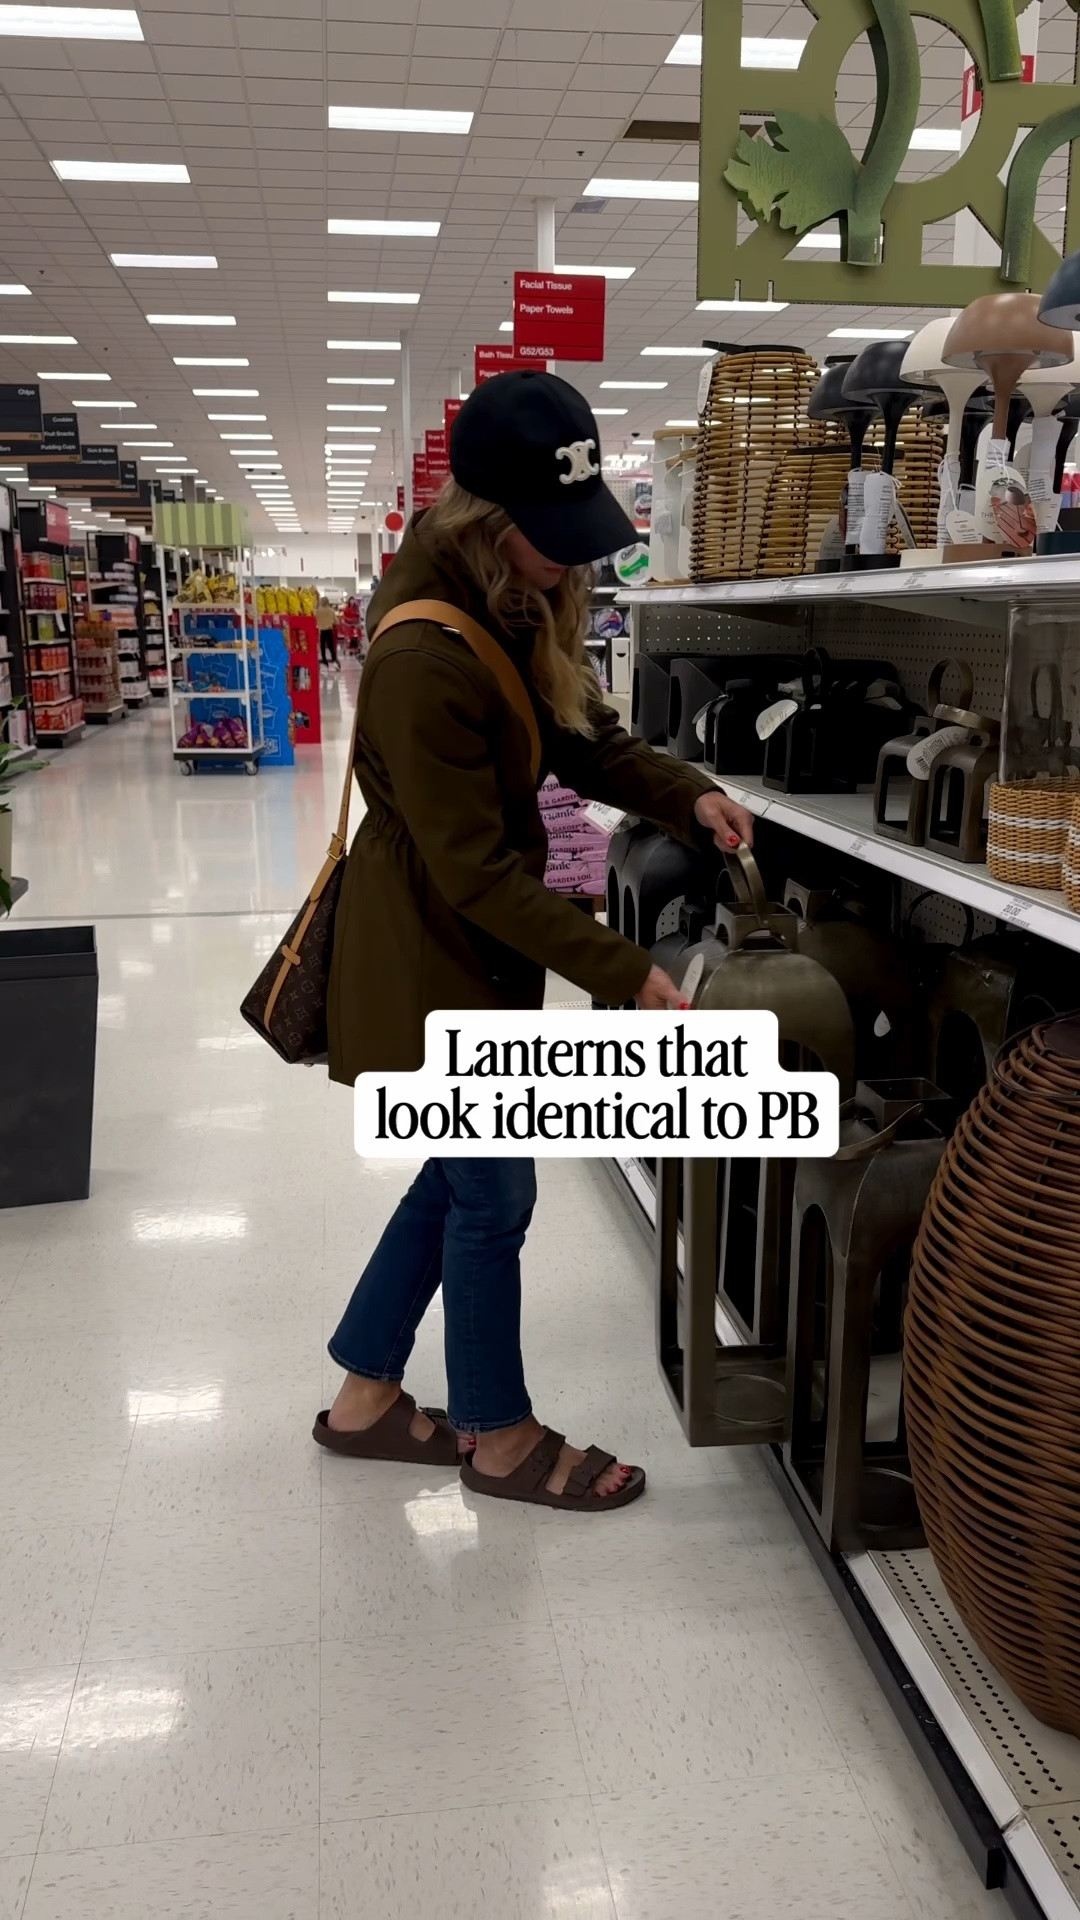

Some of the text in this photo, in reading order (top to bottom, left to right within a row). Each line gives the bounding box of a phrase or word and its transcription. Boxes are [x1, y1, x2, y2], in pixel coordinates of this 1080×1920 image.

[520, 279, 573, 291] Facial Tissue
[520, 303, 574, 315] Paper Towels
[520, 347, 554, 357] G52/G53
